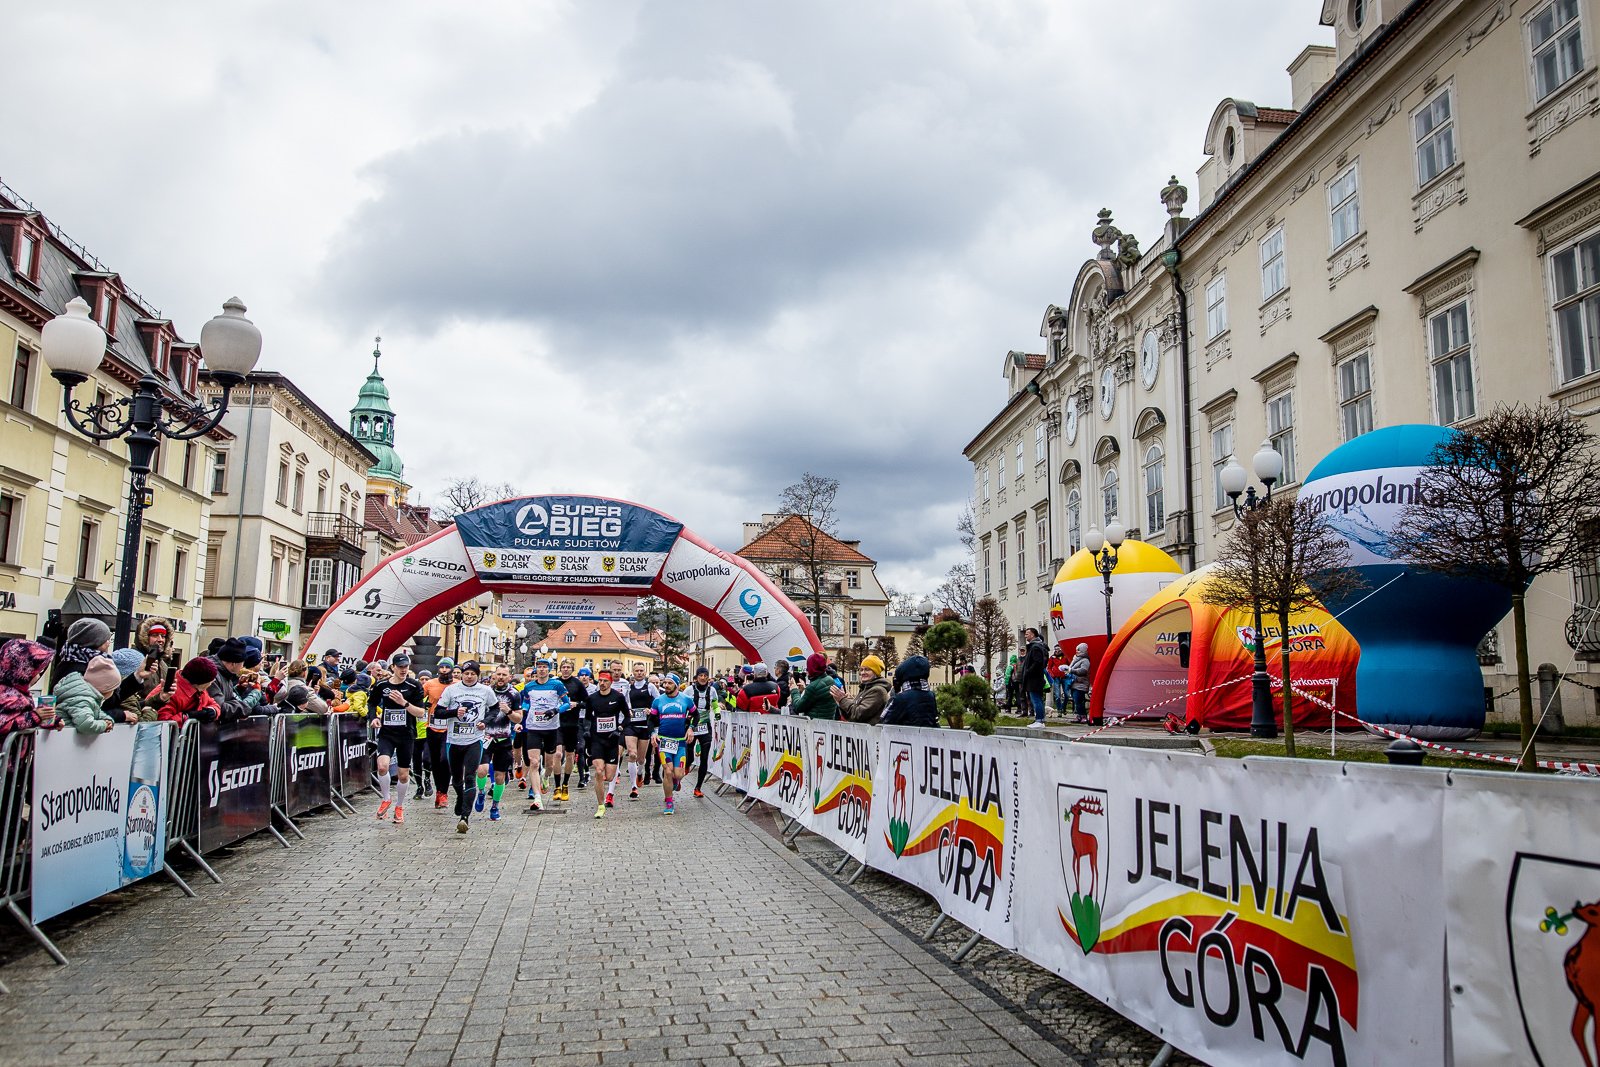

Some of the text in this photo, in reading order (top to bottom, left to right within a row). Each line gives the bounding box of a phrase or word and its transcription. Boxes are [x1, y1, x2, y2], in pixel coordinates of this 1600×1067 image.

[551, 504, 621, 517] SUPER
[550, 517, 622, 537] BIEG
[514, 537, 621, 548] PUCHAR SUDETÓW
[501, 553, 531, 562] DOLNY
[501, 561, 529, 569] ŚLĄSK
[560, 556, 591, 564] DOLNY
[620, 557, 649, 565] DOLNY
[560, 563, 589, 572] ŚLĄSK
[620, 564, 647, 573] ŚLĄSK
[666, 564, 731, 584] Staropolanka
[431, 572, 463, 581] WROCŁAW
[532, 574, 562, 582] GÓRSKIE
[569, 576, 620, 584] CHARAKTEREM
[344, 609, 396, 620] SCOTT
[1289, 677, 1339, 689] arkonoszy
[348, 742, 367, 760] SCOTT
[827, 733, 872, 780] JELENIA
[297, 751, 326, 771] SCOTT
[219, 762, 264, 793] SCOTT
[919, 745, 1004, 819] JELENIA
[41, 774, 120, 832] Staropolanka
[838, 782, 868, 844] GÓRA
[41, 845, 52, 859] JAK
[51, 840, 63, 855] COŚ
[83, 831, 94, 845] RÓB
[94, 832, 100, 842] TO
[1126, 796, 1347, 936] JELENIA
[1157, 911, 1347, 1067] GÓRA
